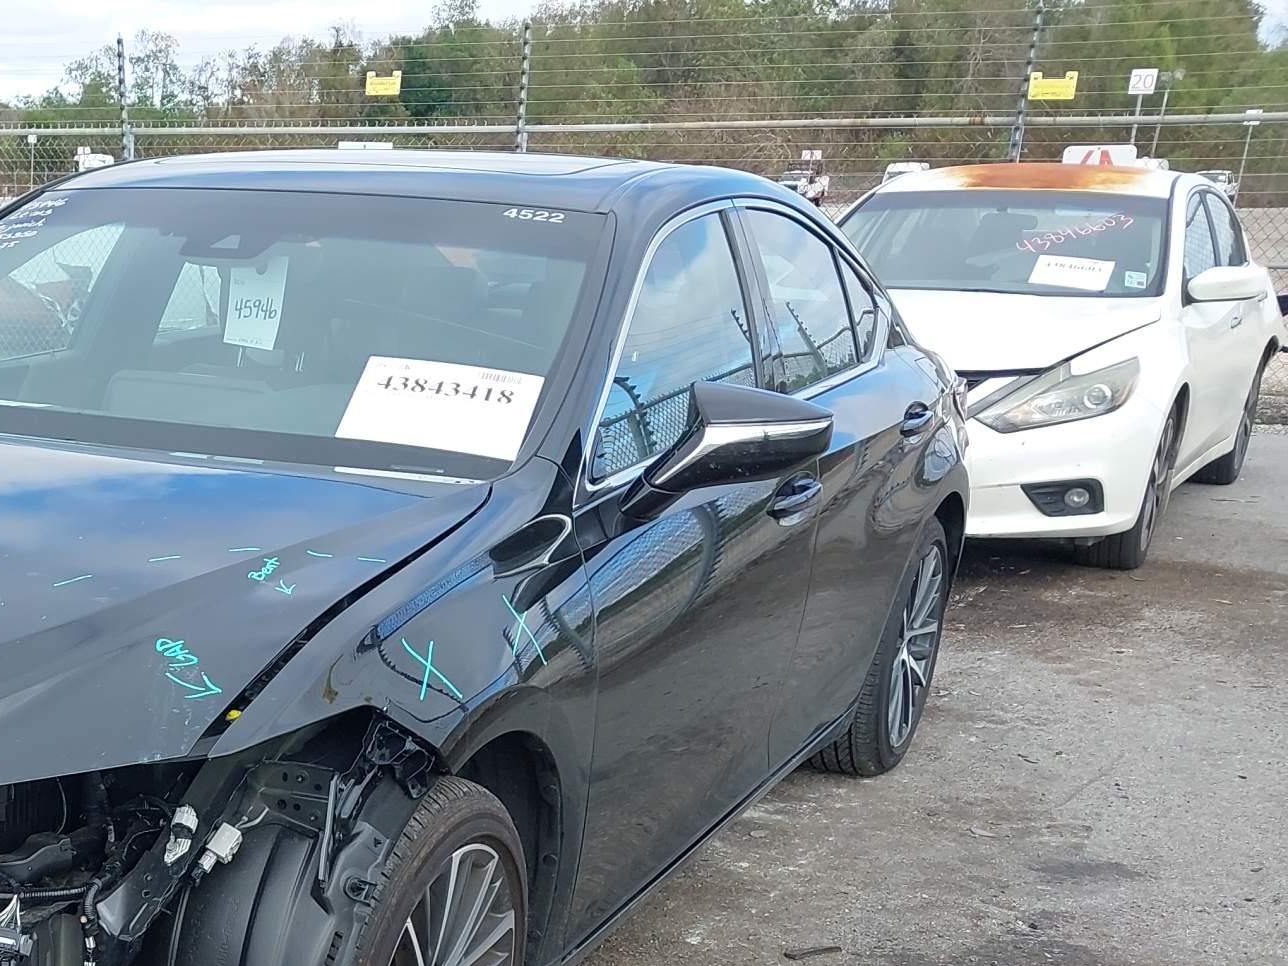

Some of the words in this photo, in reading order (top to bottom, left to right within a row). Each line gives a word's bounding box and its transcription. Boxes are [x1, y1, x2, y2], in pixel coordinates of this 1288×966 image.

[1130, 73, 1155, 89] 20
[503, 208, 565, 224] 4522
[1015, 212, 1134, 253] 43846603
[234, 297, 278, 320] 45946
[377, 375, 515, 405] 43843418
